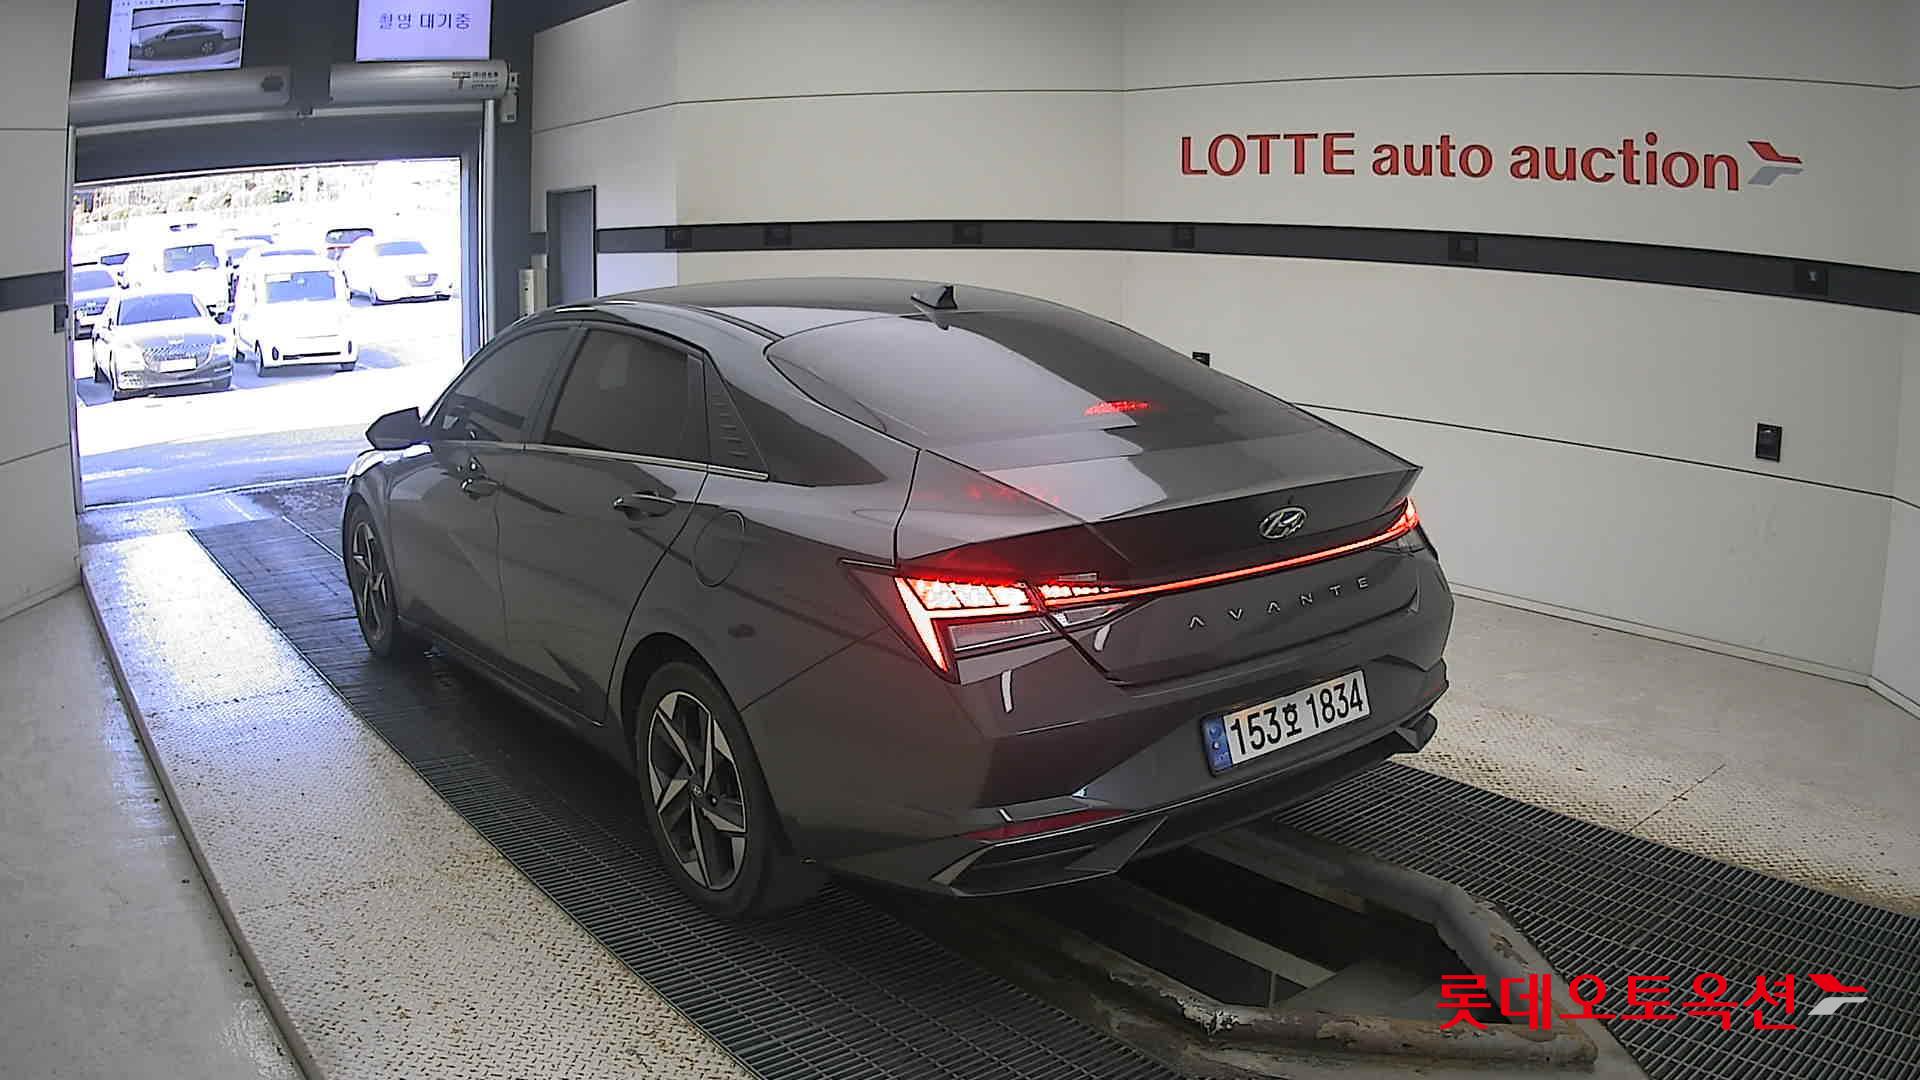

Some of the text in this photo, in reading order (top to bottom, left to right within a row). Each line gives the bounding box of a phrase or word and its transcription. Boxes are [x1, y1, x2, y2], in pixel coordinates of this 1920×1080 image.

[420, 13, 472, 30] 대기중
[1181, 131, 1740, 191] LOTTE auto auction
[1188, 576, 1369, 630] AVANTE
[1230, 677, 1364, 755] 153호 1834
